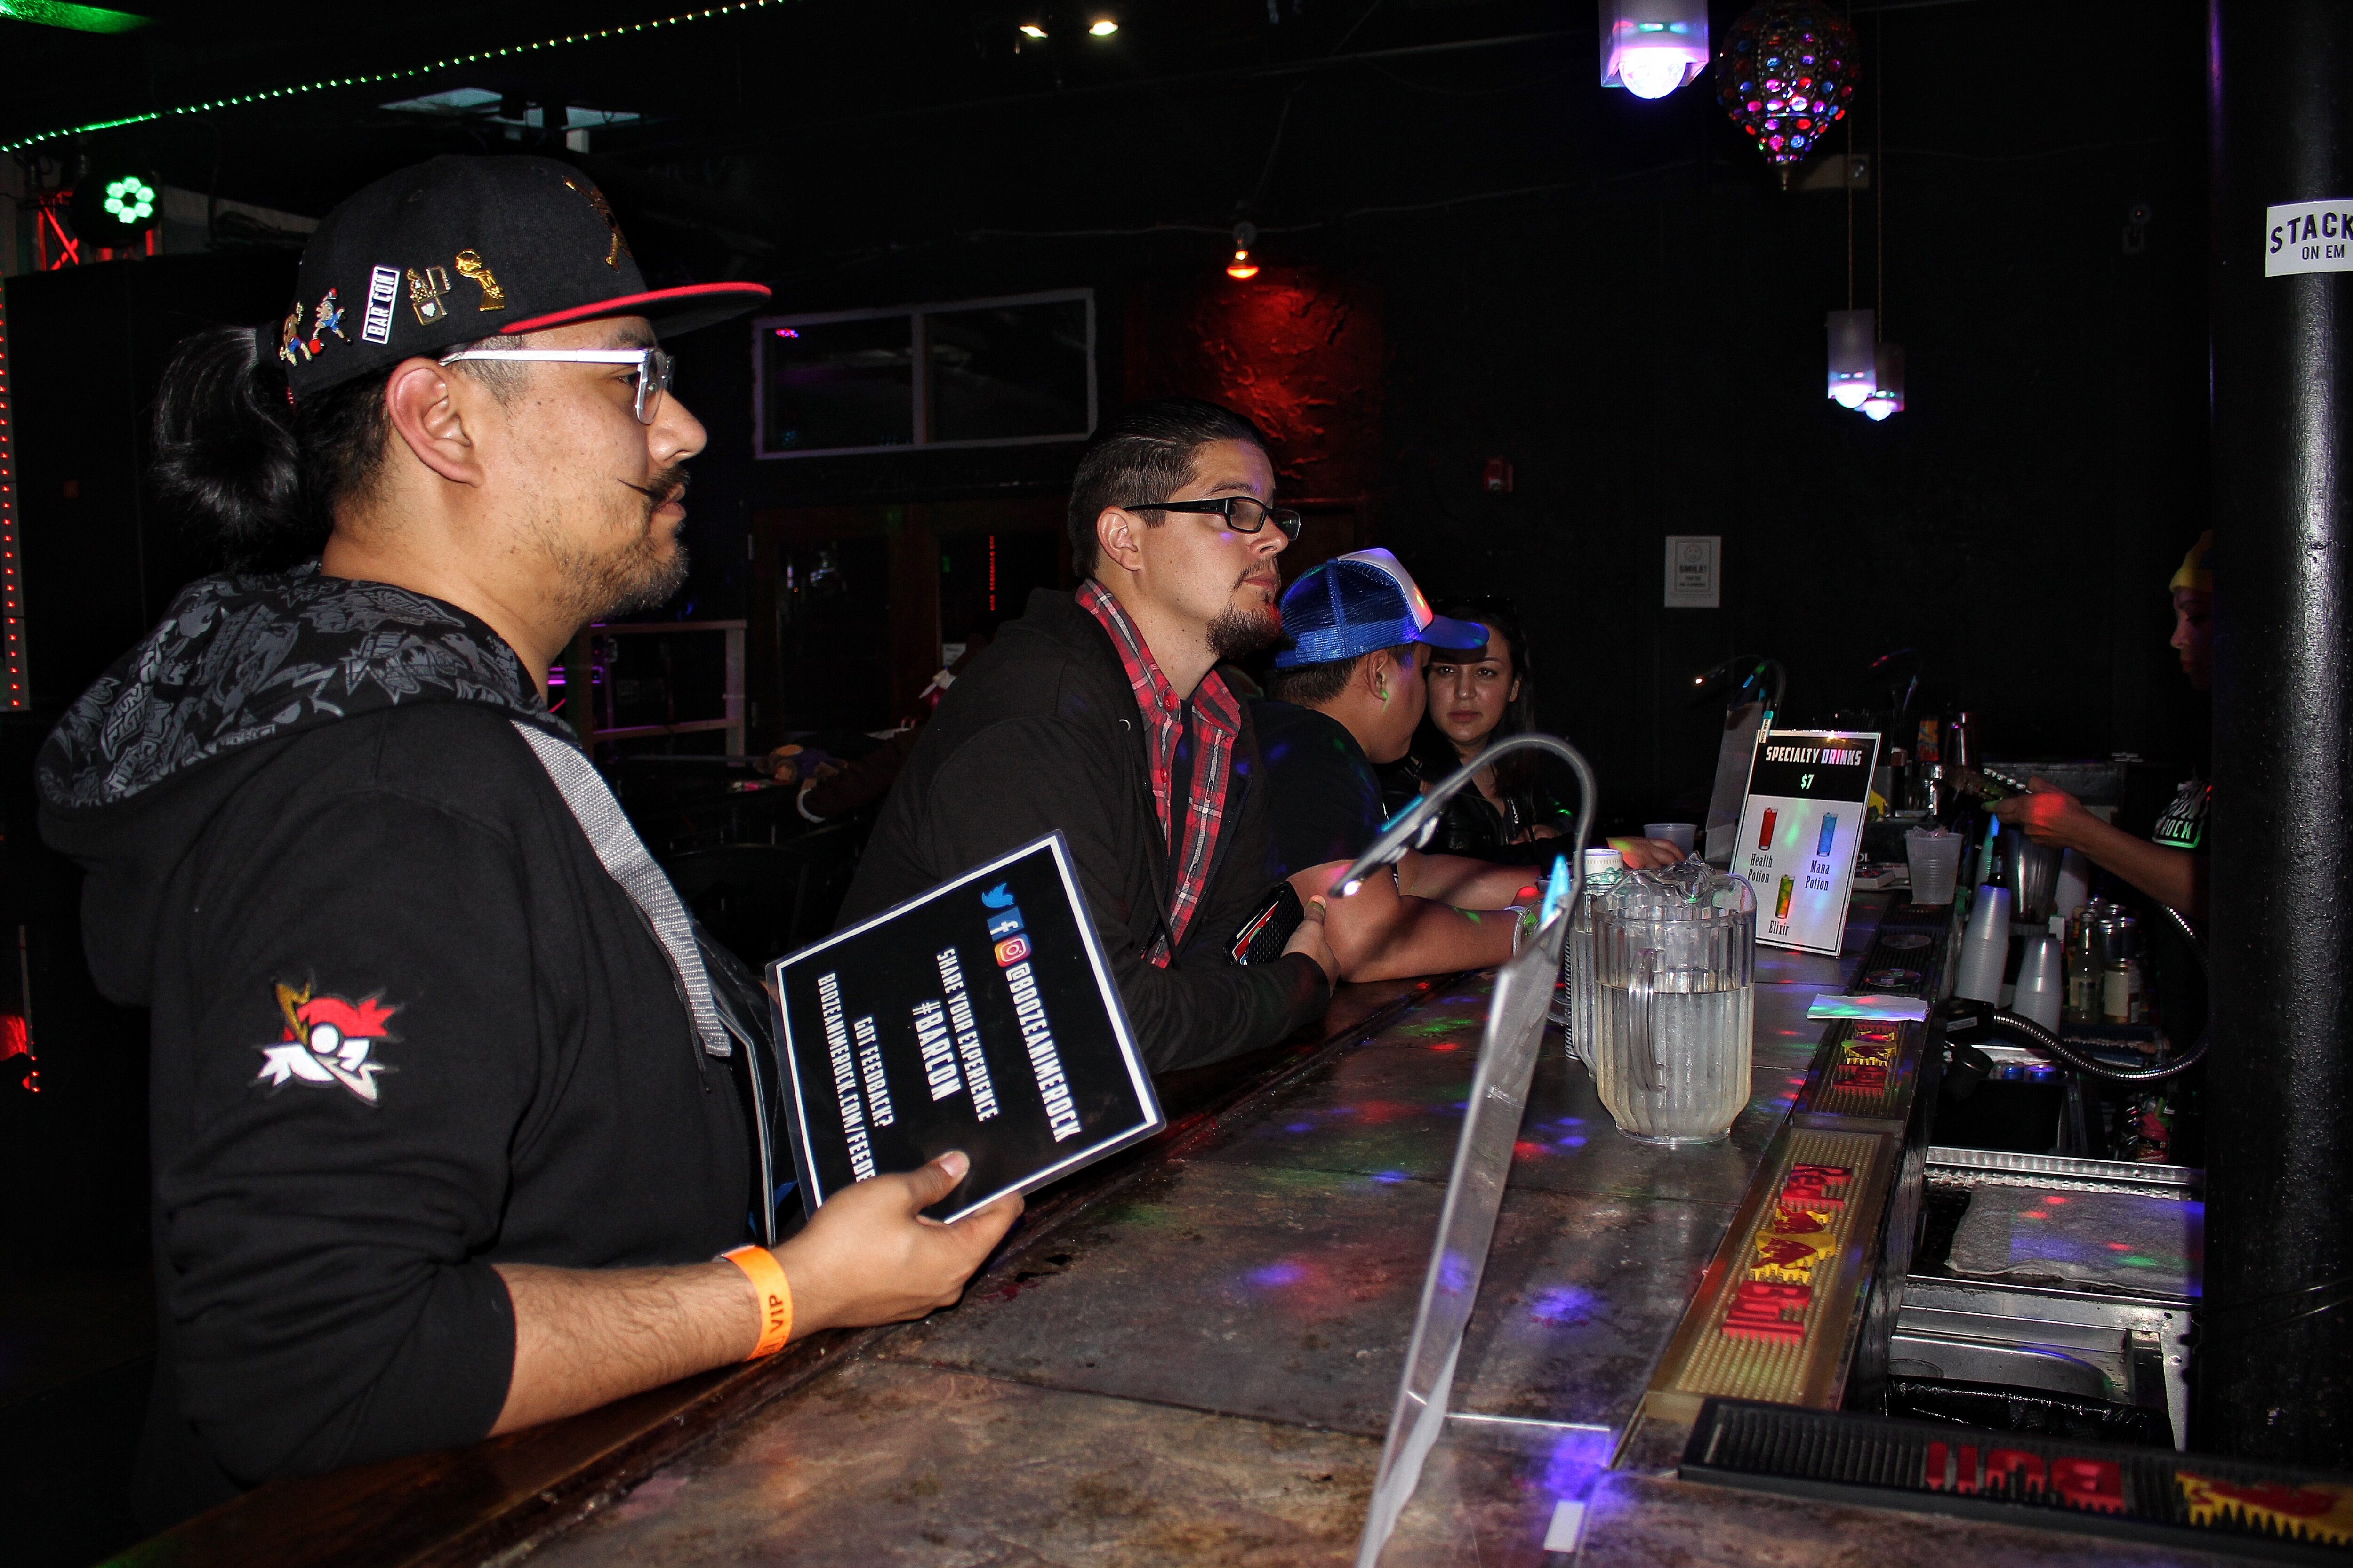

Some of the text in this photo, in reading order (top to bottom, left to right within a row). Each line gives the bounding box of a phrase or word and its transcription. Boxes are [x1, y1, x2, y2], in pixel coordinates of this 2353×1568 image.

[2269, 211, 2353, 254] STACK
[2301, 244, 2345, 260] ON EM
[367, 274, 395, 336] BAR CON
[1766, 746, 1862, 766] SPECIALTY DRINKS
[1801, 773, 1815, 790] $7
[1748, 869, 1770, 883] Potion
[1750, 853, 1773, 868] Health
[1810, 860, 1830, 875] Mana
[1805, 875, 1829, 891] Potion
[1768, 920, 1789, 936] Elixir
[912, 1000, 961, 1102] #BARCON
[937, 948, 999, 1123] SHARE YOUR EXPERIENCE
[1005, 962, 1082, 1143] @BOOZEANIMEROCK
[854, 1016, 894, 1128] GOT FEEDBACK?
[769, 1294, 784, 1334] VIP
[1721, 1280, 1812, 1345] Bull
[1926, 1440, 2127, 1515] Bull
